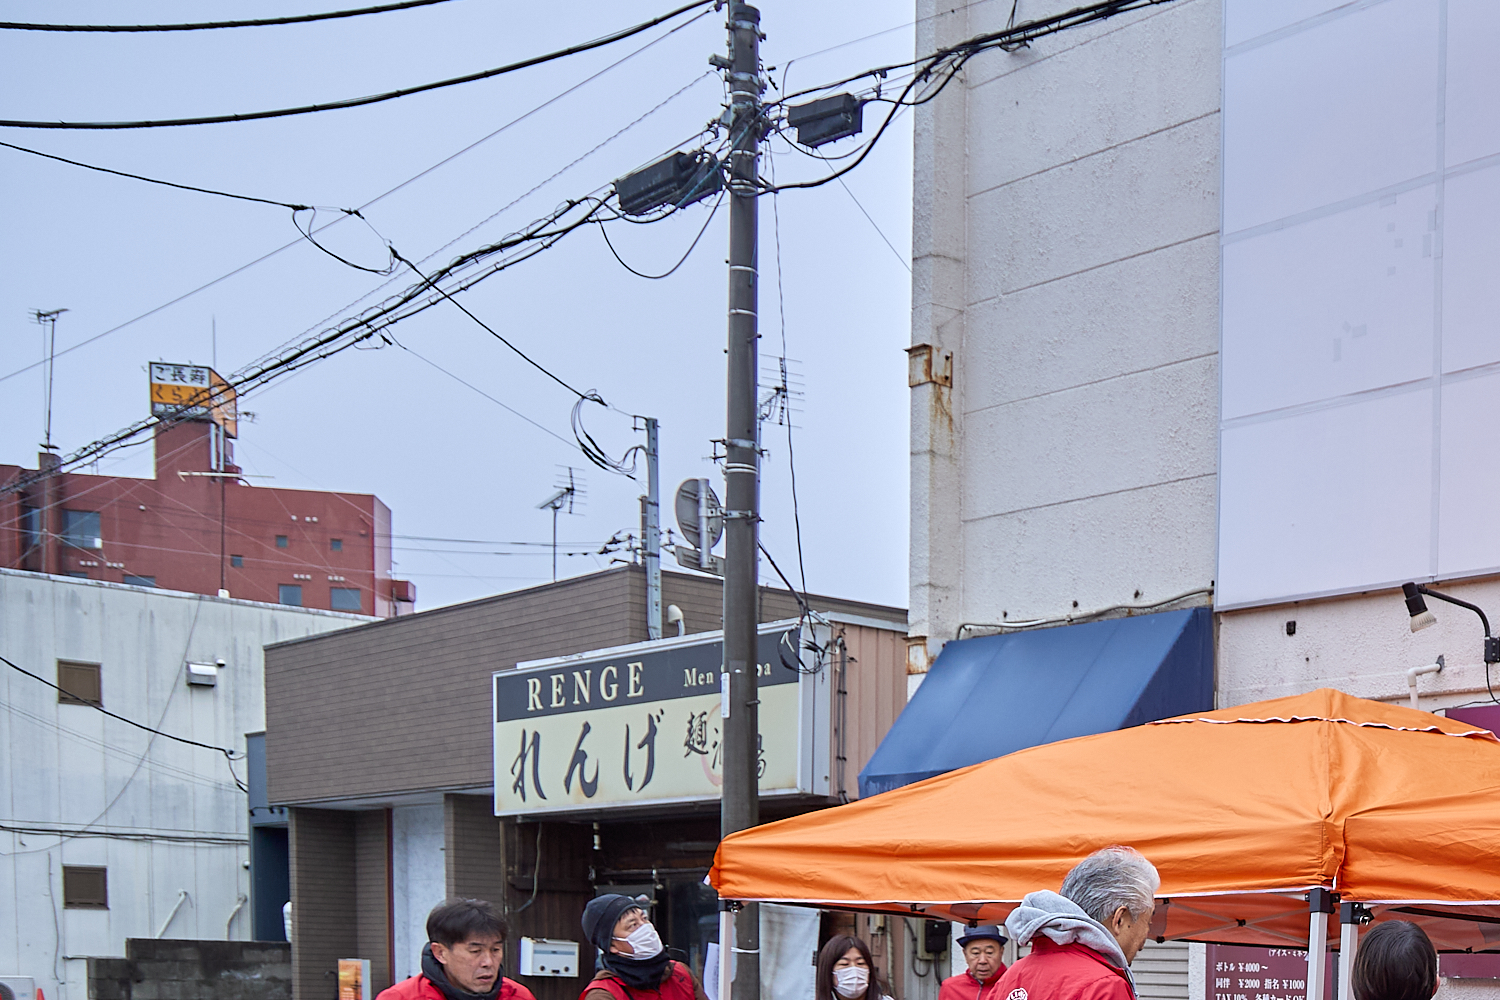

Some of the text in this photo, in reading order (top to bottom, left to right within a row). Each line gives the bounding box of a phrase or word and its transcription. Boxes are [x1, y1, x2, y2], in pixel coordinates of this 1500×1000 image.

[526, 661, 645, 712] RENGE
[683, 667, 714, 688] Men
[510, 708, 665, 803] れんげ
[1216, 962, 1236, 973] ボトル
[1215, 977, 1305, 990] 同伴 ¥2000 指名 ¥1000
